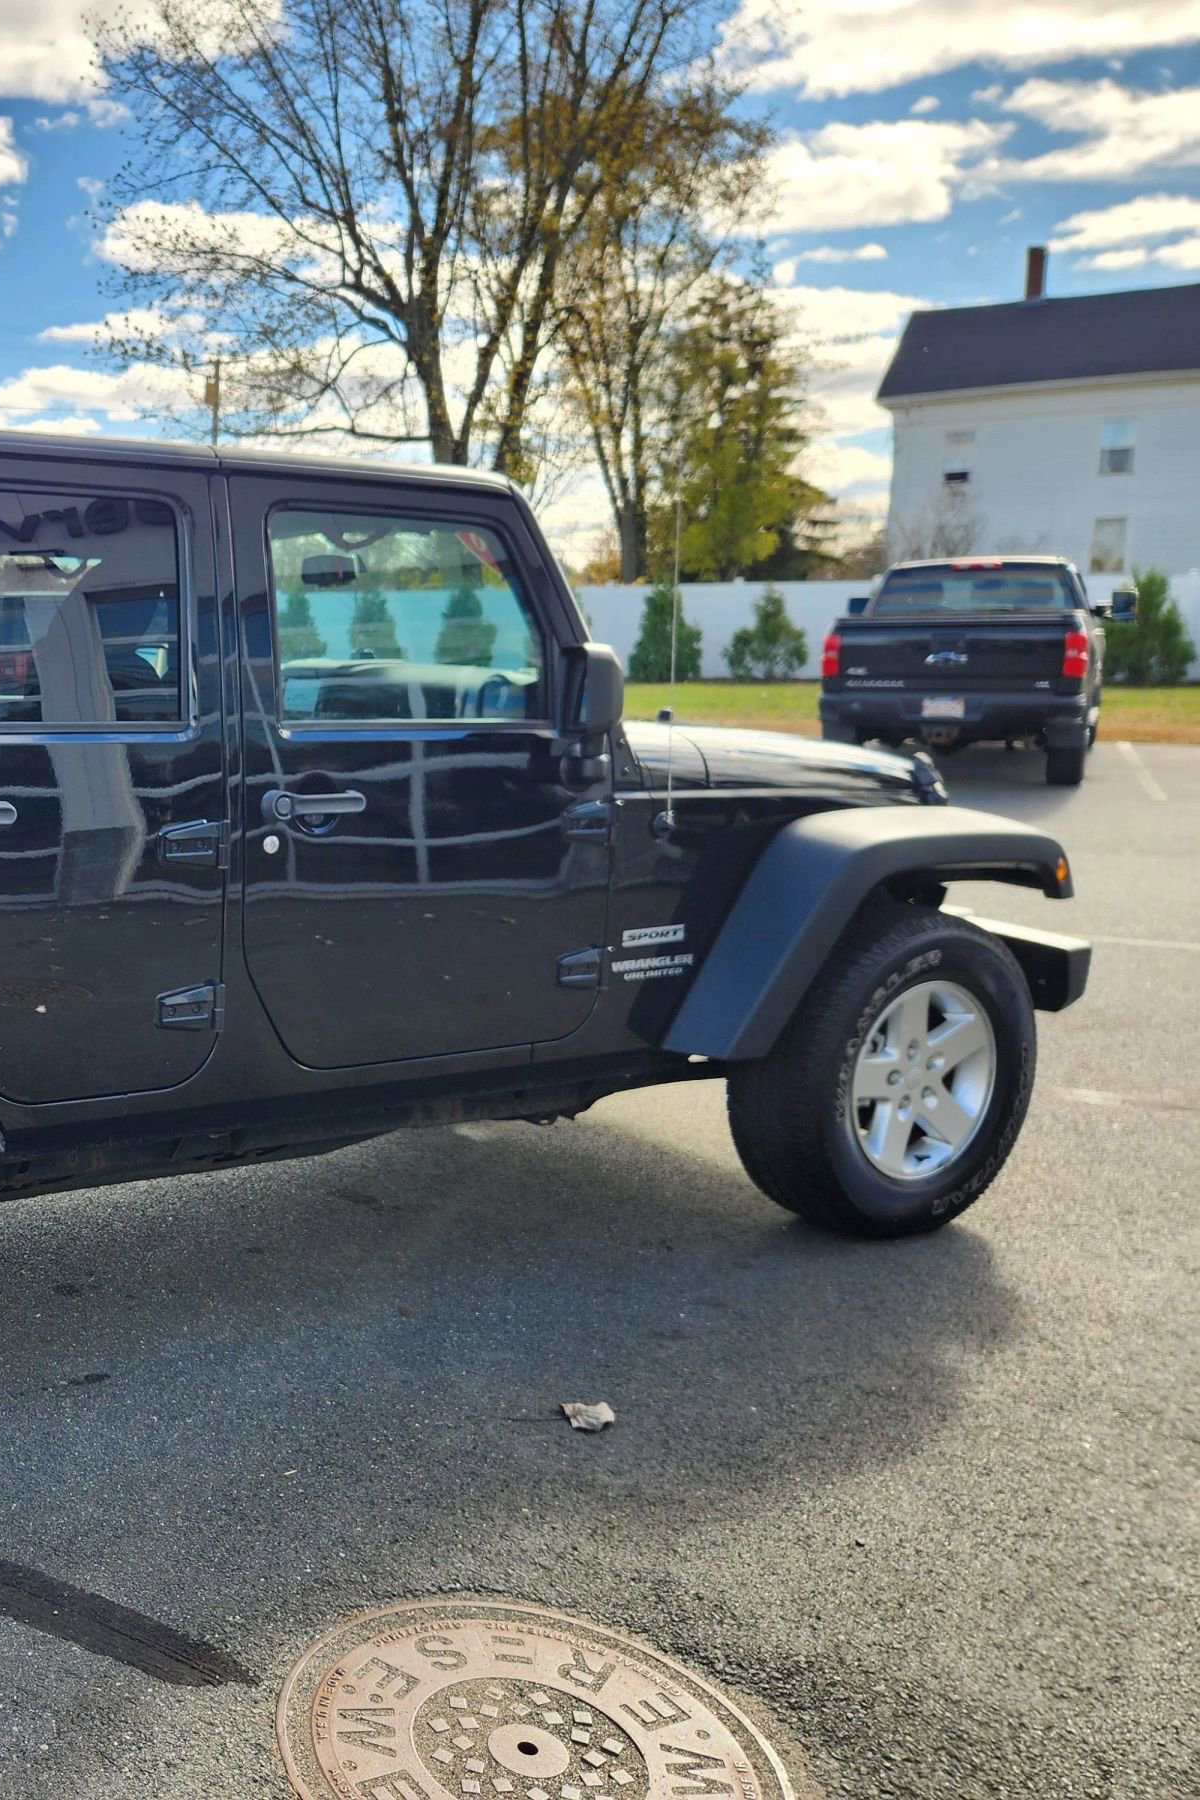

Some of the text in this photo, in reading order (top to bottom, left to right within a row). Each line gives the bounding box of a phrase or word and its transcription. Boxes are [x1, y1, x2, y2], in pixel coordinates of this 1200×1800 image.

[626, 927, 682, 942] SPORT
[611, 954, 693, 973] WRANGLER
[517, 1624, 608, 1657] FOUNDRIES
[326, 1667, 347, 1694] MADE
[615, 1654, 685, 1698] GENERAL
[319, 1695, 331, 1708] IN
